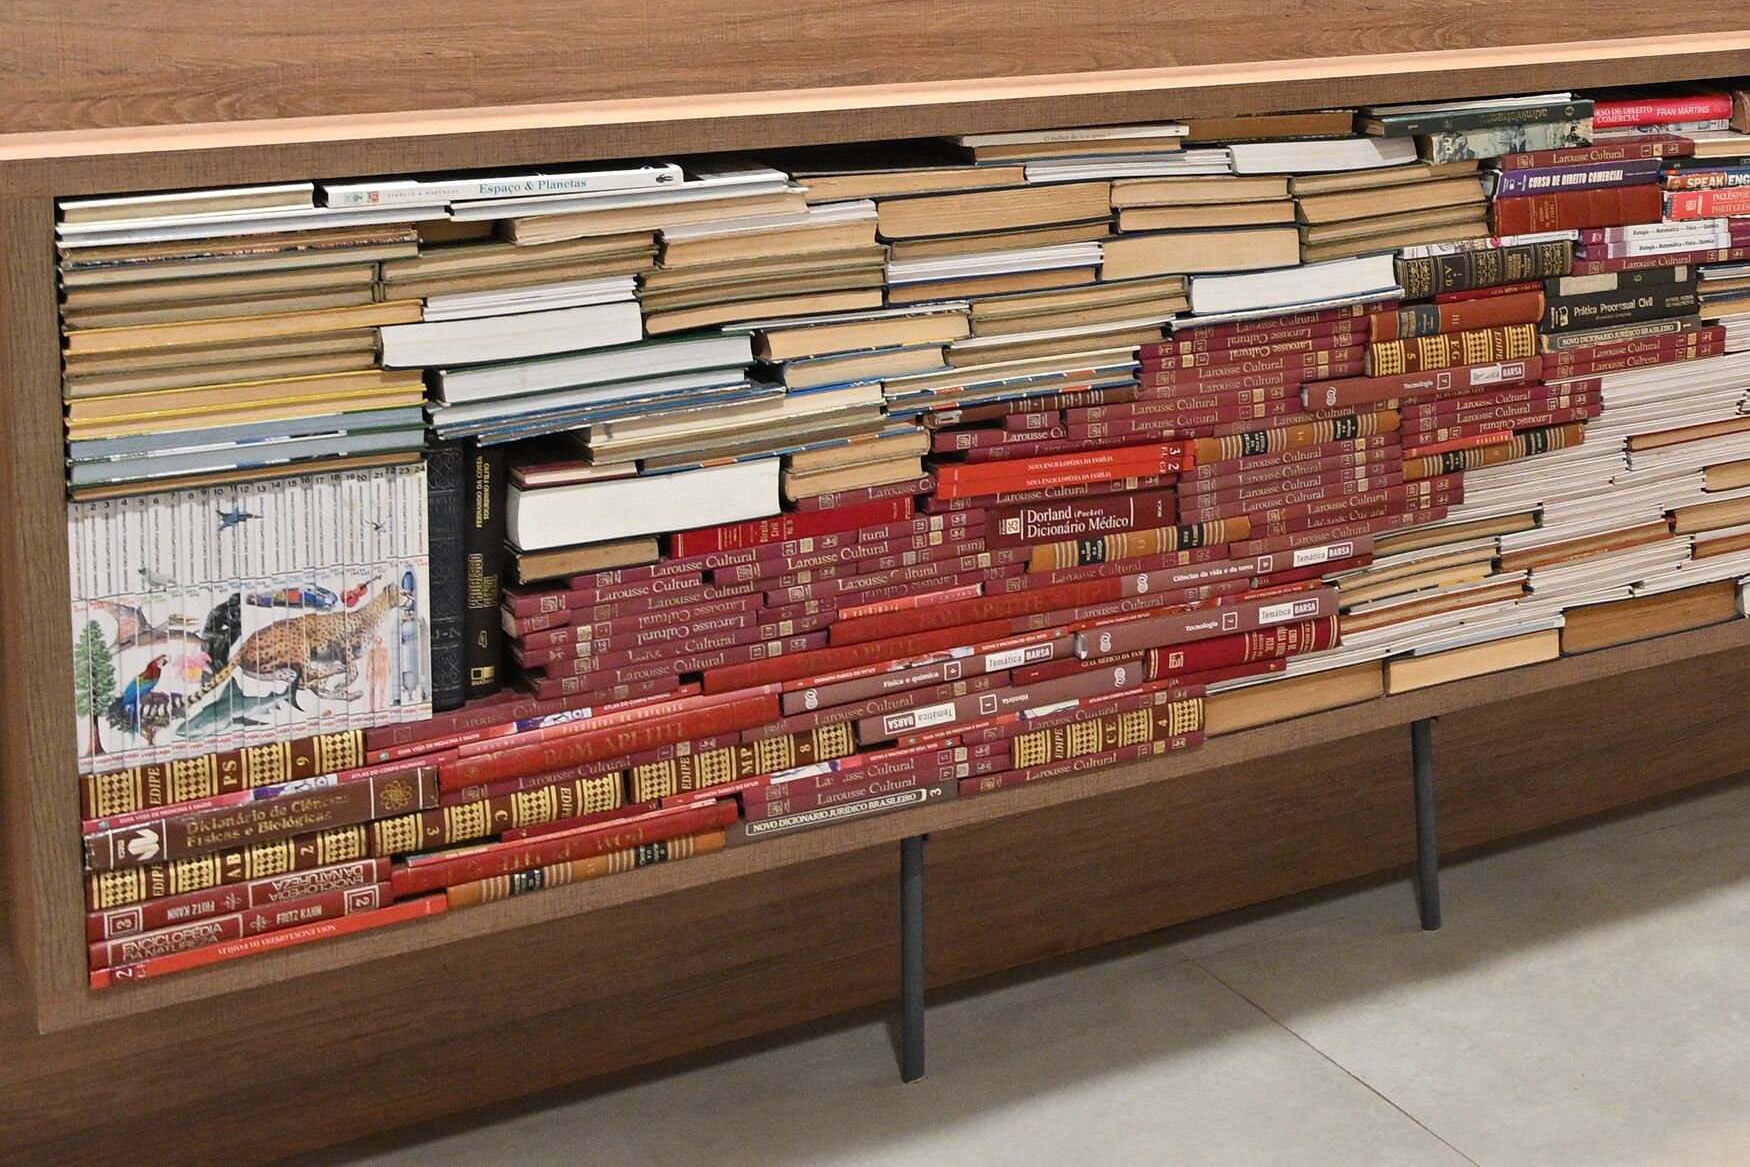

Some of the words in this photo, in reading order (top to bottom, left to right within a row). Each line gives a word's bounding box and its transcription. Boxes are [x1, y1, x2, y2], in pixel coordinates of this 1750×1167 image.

[1598, 115, 1640, 123] COMERCIAL
[1612, 107, 1622, 115] DE
[1623, 106, 1652, 114] DIREITO
[1657, 108, 1676, 116] FRAN
[1678, 106, 1709, 115] MARTINS
[1553, 151, 1589, 164] Larousse
[1590, 148, 1625, 160] Cultural
[479, 182, 522, 195] Espaço
[524, 180, 533, 190] &
[538, 178, 587, 190] Planetas
[1528, 176, 1550, 189] CURSO
[1552, 175, 1560, 186] DE
[1561, 173, 1586, 186] DIREITO
[1588, 169, 1624, 184] COMERCIAL
[1687, 174, 1724, 187] SPEAK
[1703, 222, 1719, 230] Química
[1639, 243, 1655, 251] Biologia
[1699, 237, 1715, 245] Química
[1623, 259, 1657, 270] Larousse
[1658, 255, 1691, 268] Cultural
[1574, 304, 1597, 316] Prática
[1600, 299, 1636, 313] Processual
[1638, 296, 1653, 308] Civil
[1236, 321, 1279, 333] Larousse
[1280, 314, 1319, 327] Cultural
[1227, 334, 1269, 347] Cultural
[1270, 328, 1311, 340] Larousse
[1229, 347, 1270, 360] Cultural
[1271, 340, 1313, 353] Larousse
[1592, 346, 1626, 359] Larousse
[1627, 341, 1660, 355] Cultural
[1199, 366, 1241, 379] Larousse
[1242, 359, 1283, 374] Cultural
[1591, 361, 1625, 372] Larousse
[1626, 356, 1660, 368] Cultural
[1199, 382, 1242, 394] Larousse
[1243, 374, 1284, 388] Cultural
[1404, 378, 1433, 390] Tecnologia
[1131, 402, 1174, 415] Larousse
[1177, 393, 1218, 408] Cultural
[1456, 399, 1493, 410] Larousse
[1495, 392, 1531, 405] Cultural
[1131, 419, 1175, 431] Larousse
[1177, 412, 1219, 426] Cultural
[1273, 414, 1315, 426] Larousse
[1316, 406, 1355, 421] Cultural
[1457, 411, 1493, 423] Larousse
[1495, 405, 1530, 419] Cultural
[1518, 414, 1552, 426] Larousse
[1479, 420, 1515, 433] Cultural
[1240, 457, 1281, 471] Larousse
[1282, 449, 1321, 464] Cultural
[1239, 471, 1281, 485] Larousse
[1283, 462, 1321, 478] Cultural
[476, 482, 483, 492] DA
[996, 491, 1042, 503] Larousse
[1044, 484, 1088, 499] Cultural
[1239, 486, 1281, 500] Larousse
[1282, 477, 1321, 492] Cultural
[475, 493, 483, 528] FERNANDO
[1242, 498, 1284, 512] Larousse
[1285, 490, 1325, 505] Cultural
[1307, 501, 1348, 515] Larousse
[1349, 492, 1388, 507] Cultural
[1027, 507, 1072, 524] Dorland
[1073, 507, 1104, 519] (Pocket)
[1027, 521, 1086, 539] Dicionário
[1088, 516, 1129, 531] Médico
[1289, 532, 1331, 545] Larousse
[1332, 523, 1370, 538] Cultural
[787, 554, 837, 569] Larousse
[840, 543, 889, 559] Cultural
[1296, 551, 1326, 562] Temática
[1329, 545, 1351, 558] BARSA
[650, 562, 702, 577] Larousse
[706, 550, 757, 568] Cultural
[468, 553, 484, 609] PROCESSO
[648, 596, 701, 610] Larousse
[703, 582, 754, 599] Cultural
[694, 599, 746, 615] Larousse
[1074, 605, 1120, 620] Larousse
[1121, 596, 1164, 612] Cultural
[1261, 606, 1291, 618] Temática
[1294, 602, 1316, 614] BARSA
[639, 610, 690, 629] Cultural
[1184, 620, 1218, 632] Tecnologia
[988, 655, 1023, 669] Temática
[1025, 646, 1051, 660] BARSA
[616, 667, 671, 682] Larousse
[673, 654, 724, 670] Cultural
[814, 708, 864, 725] Larousse
[866, 696, 914, 715] Cultural
[918, 707, 953, 722] Temática
[888, 715, 915, 730] BARSA
[1158, 719, 1168, 727] 4
[800, 744, 811, 753] 8
[1055, 728, 1063, 758] EDIPE
[681, 757, 690, 789] EDIPE
[1026, 766, 1071, 780] Larousse
[1074, 754, 1116, 770] Cultural
[150, 767, 161, 805] EDIPE
[817, 789, 867, 805] Larousse
[869, 776, 916, 793] Cultural
[560, 787, 572, 819] EDIPE
[753, 819, 778, 832] NOVO
[868, 792, 916, 810] BRASILEIRO
[186, 810, 265, 834] Dicionário
[269, 804, 287, 815] de
[427, 827, 439, 835] 3
[301, 845, 314, 854] 2
[153, 864, 164, 896] EDIPE
[167, 905, 190, 919] KAHN
[193, 900, 215, 911] FRITZ
[276, 910, 298, 924] FRITZ
[300, 906, 322, 920] KAHN
[122, 923, 223, 953] ENCICLOPÉDIA
